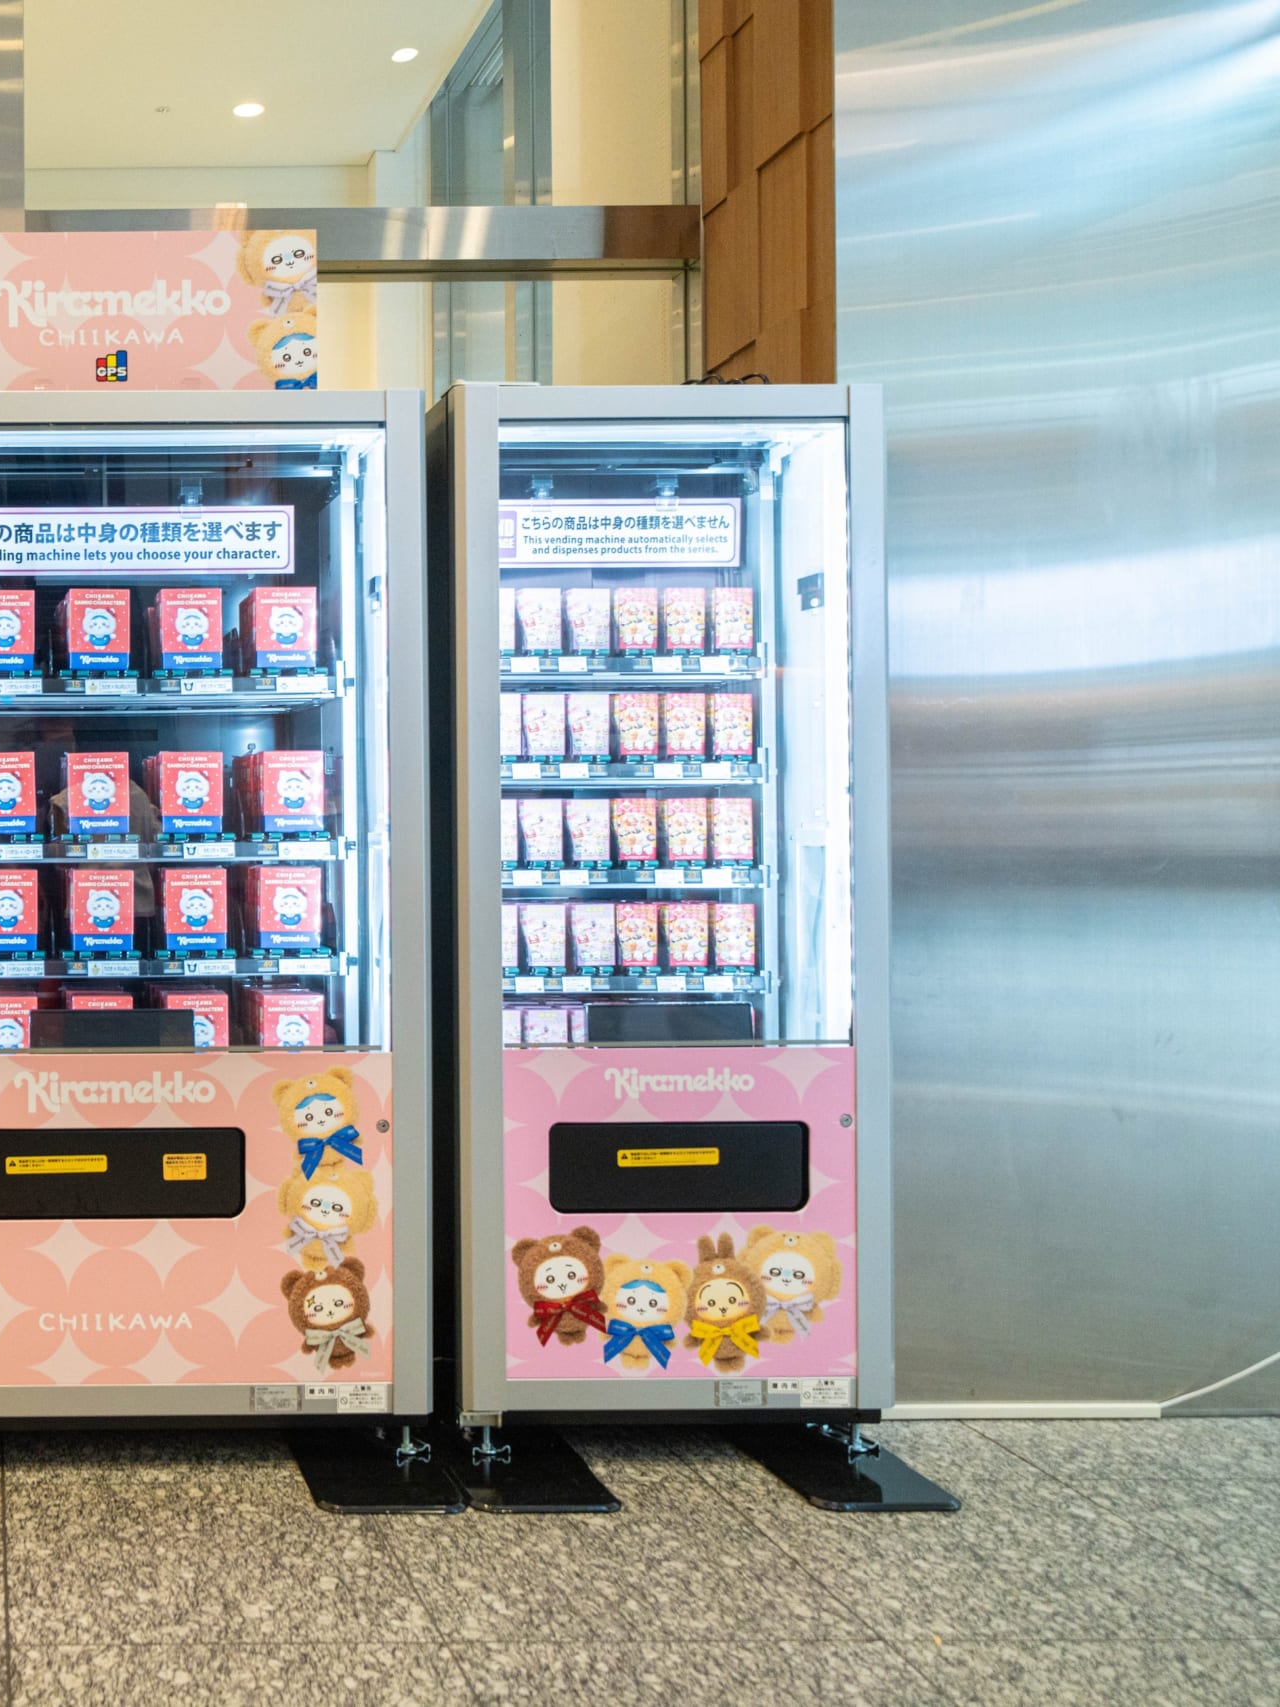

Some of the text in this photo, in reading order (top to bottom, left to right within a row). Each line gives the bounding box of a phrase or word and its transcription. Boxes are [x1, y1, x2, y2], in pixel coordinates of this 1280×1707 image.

[39, 328, 184, 346] CHIIKAWA
[97, 366, 127, 377] GPS
[522, 516, 730, 530] こちらの商品は中身の種類を選べません
[523, 534, 728, 546] This vending machine automatically selects
[26, 548, 80, 561] machine
[84, 548, 106, 560] lets
[110, 550, 133, 563] you
[136, 548, 180, 560] choose
[184, 550, 213, 562] your
[216, 548, 280, 559] character.
[532, 545, 718, 556] and dispenses products from the series.
[604, 1067, 754, 1100] Kiramekko
[14, 1071, 216, 1114] Kiramekko
[39, 1312, 193, 1332] CHIIKAWA
